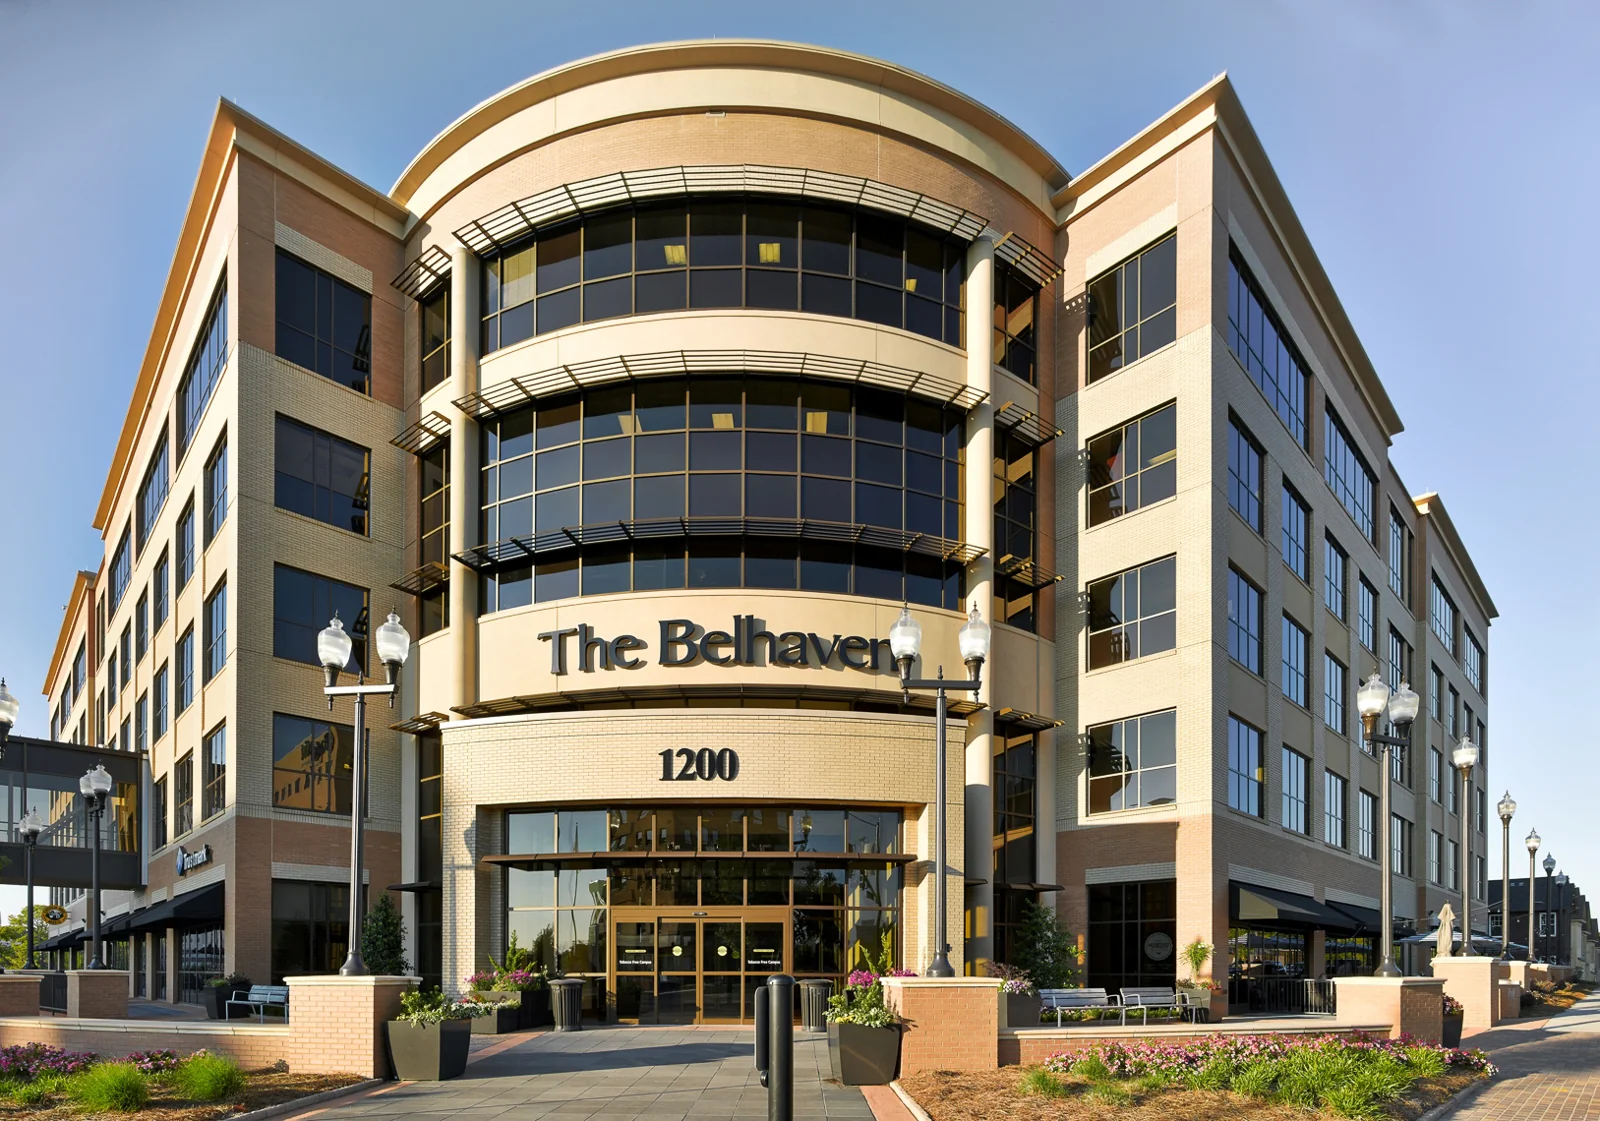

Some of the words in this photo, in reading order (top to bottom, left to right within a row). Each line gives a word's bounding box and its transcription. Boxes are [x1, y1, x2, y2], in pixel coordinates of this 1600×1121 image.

[537, 623, 640, 675] The
[658, 614, 900, 672] Belhaven
[658, 747, 739, 781] 1200
